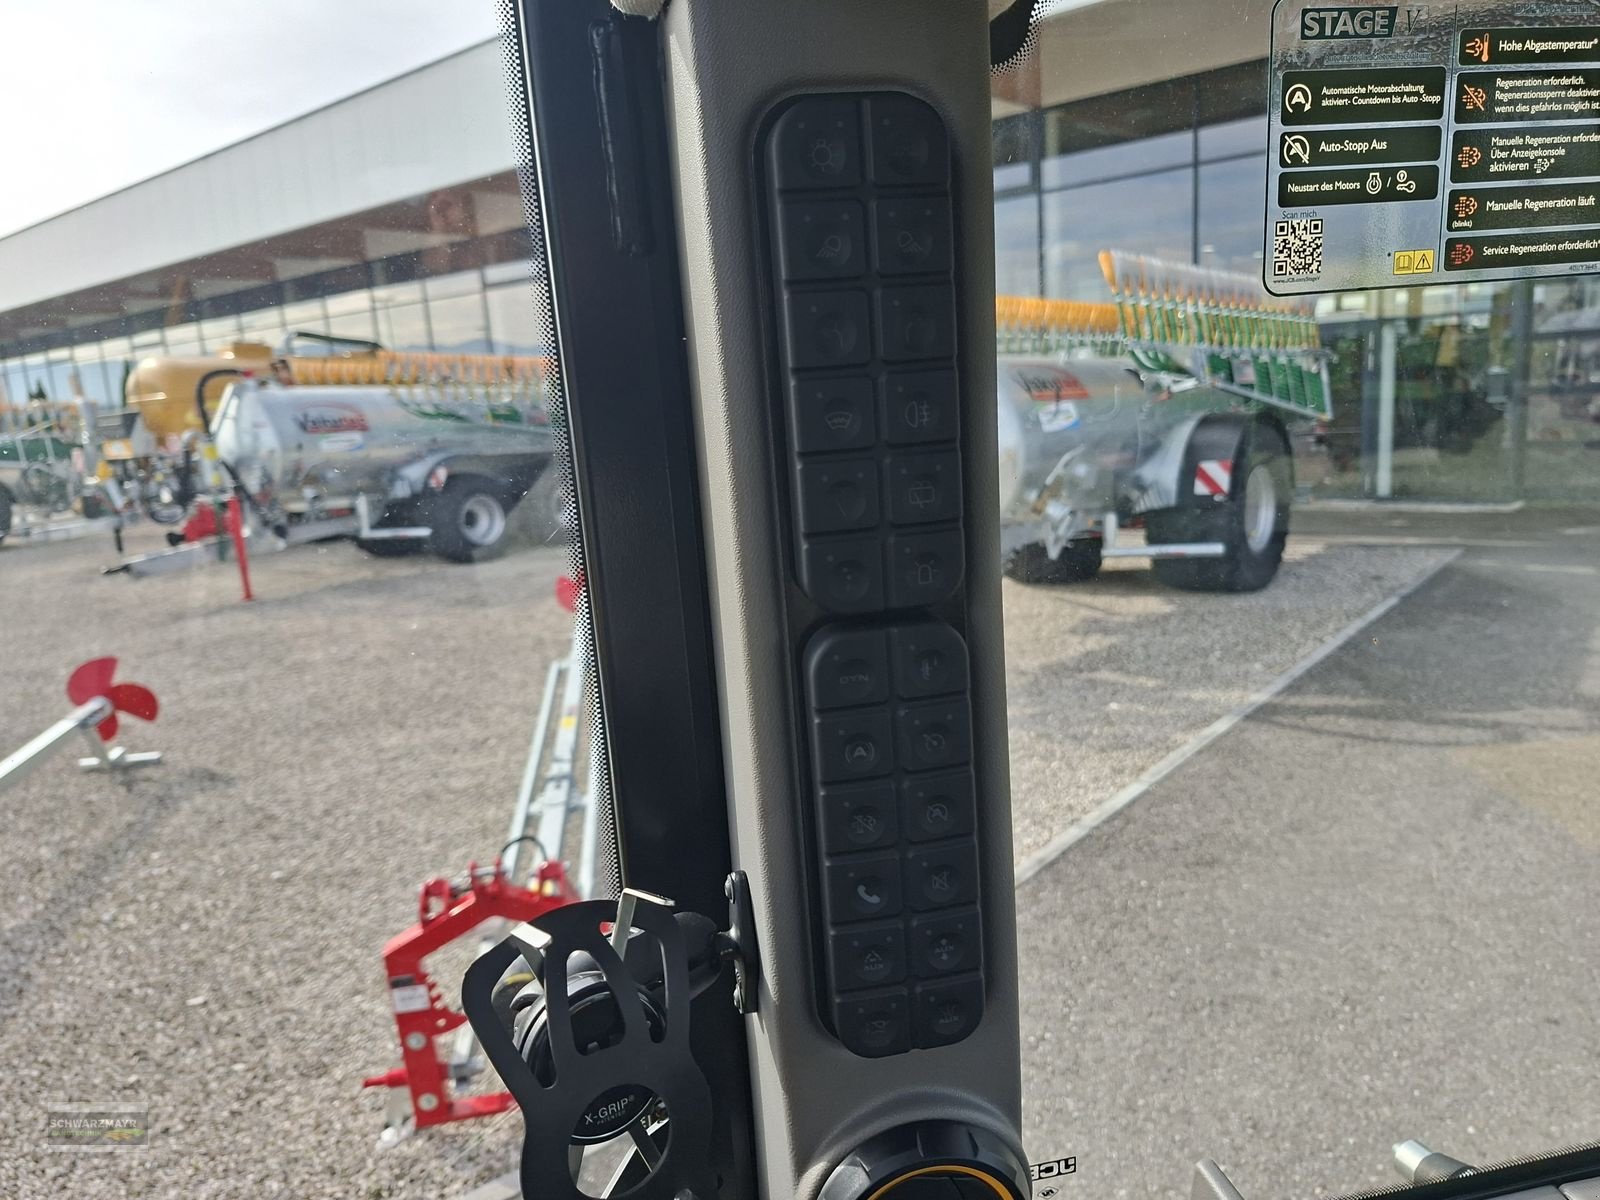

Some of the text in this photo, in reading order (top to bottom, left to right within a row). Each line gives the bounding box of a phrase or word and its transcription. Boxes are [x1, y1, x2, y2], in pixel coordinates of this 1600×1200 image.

[1303, 10, 1390, 37] STAGE
[1498, 40, 1522, 51] Hohe
[1321, 83, 1425, 95] Automatische Motorabschaltung
[1496, 76, 1585, 90] Regeneration erforderlich.
[1321, 97, 1351, 107] aktiviert-
[1352, 96, 1391, 106] Countdown
[1391, 95, 1401, 104] bis
[1401, 94, 1418, 103] Auto
[1495, 91, 1566, 102] Regenerationssperre
[1495, 105, 1514, 113] wenn
[1515, 103, 1530, 112] dies
[1531, 102, 1562, 114] gefahrlos
[1563, 101, 1590, 112] möglich
[1319, 139, 1388, 153] Auto-Stopp Aus
[1491, 136, 1523, 146] Manuelle
[1525, 134, 1571, 147] Regeneration
[1490, 147, 1566, 159] Über Anzeigekonsole
[1489, 162, 1529, 173] aktivieren
[1287, 180, 1361, 193] Neustart des Motors
[1486, 195, 1596, 211] Manuelle Regeneration läuft
[1282, 210, 1317, 219] Scan mich
[1451, 220, 1473, 229] (blinkt)
[1482, 246, 1509, 256] Service
[1509, 243, 1557, 256] Regeneration
